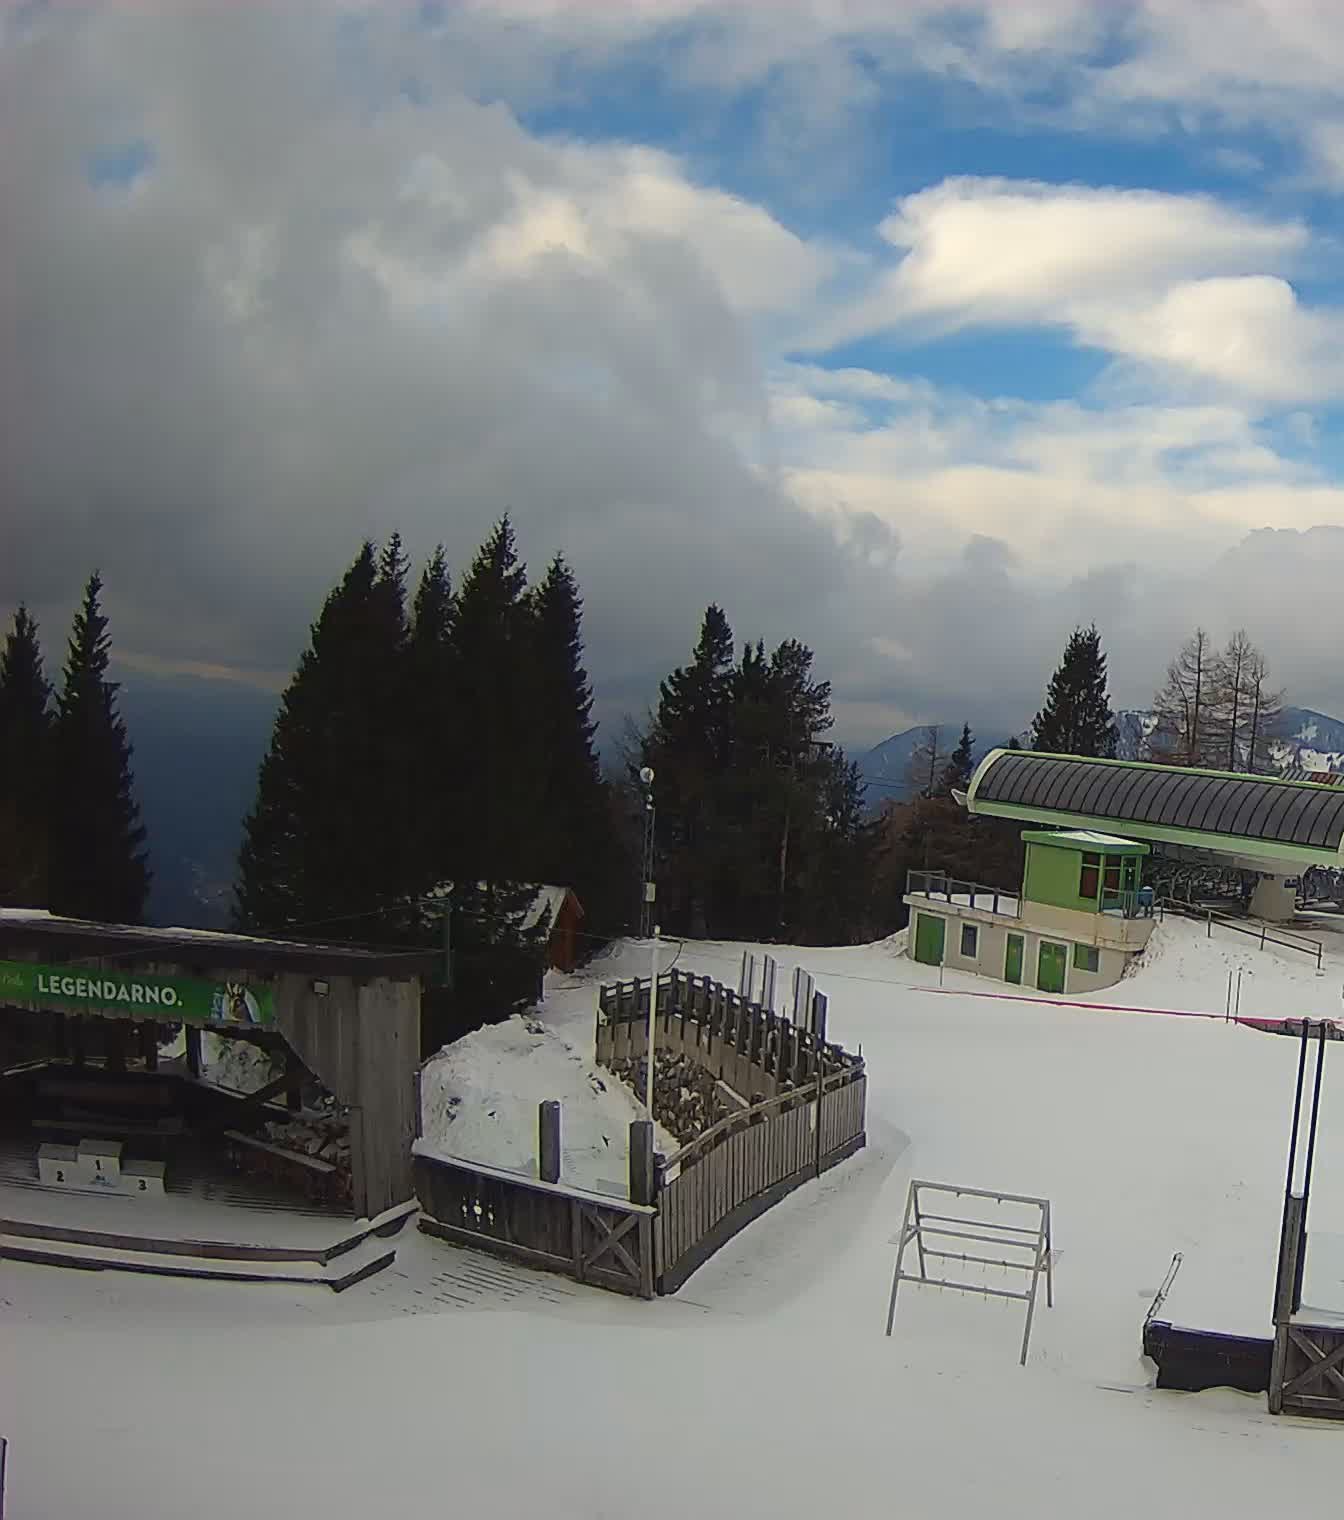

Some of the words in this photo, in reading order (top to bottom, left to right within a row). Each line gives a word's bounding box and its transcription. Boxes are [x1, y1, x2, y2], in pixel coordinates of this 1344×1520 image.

[37, 974, 183, 1007] LEGENDARNO.
[56, 1170, 65, 1182] 2
[138, 1179, 148, 1191] 3
